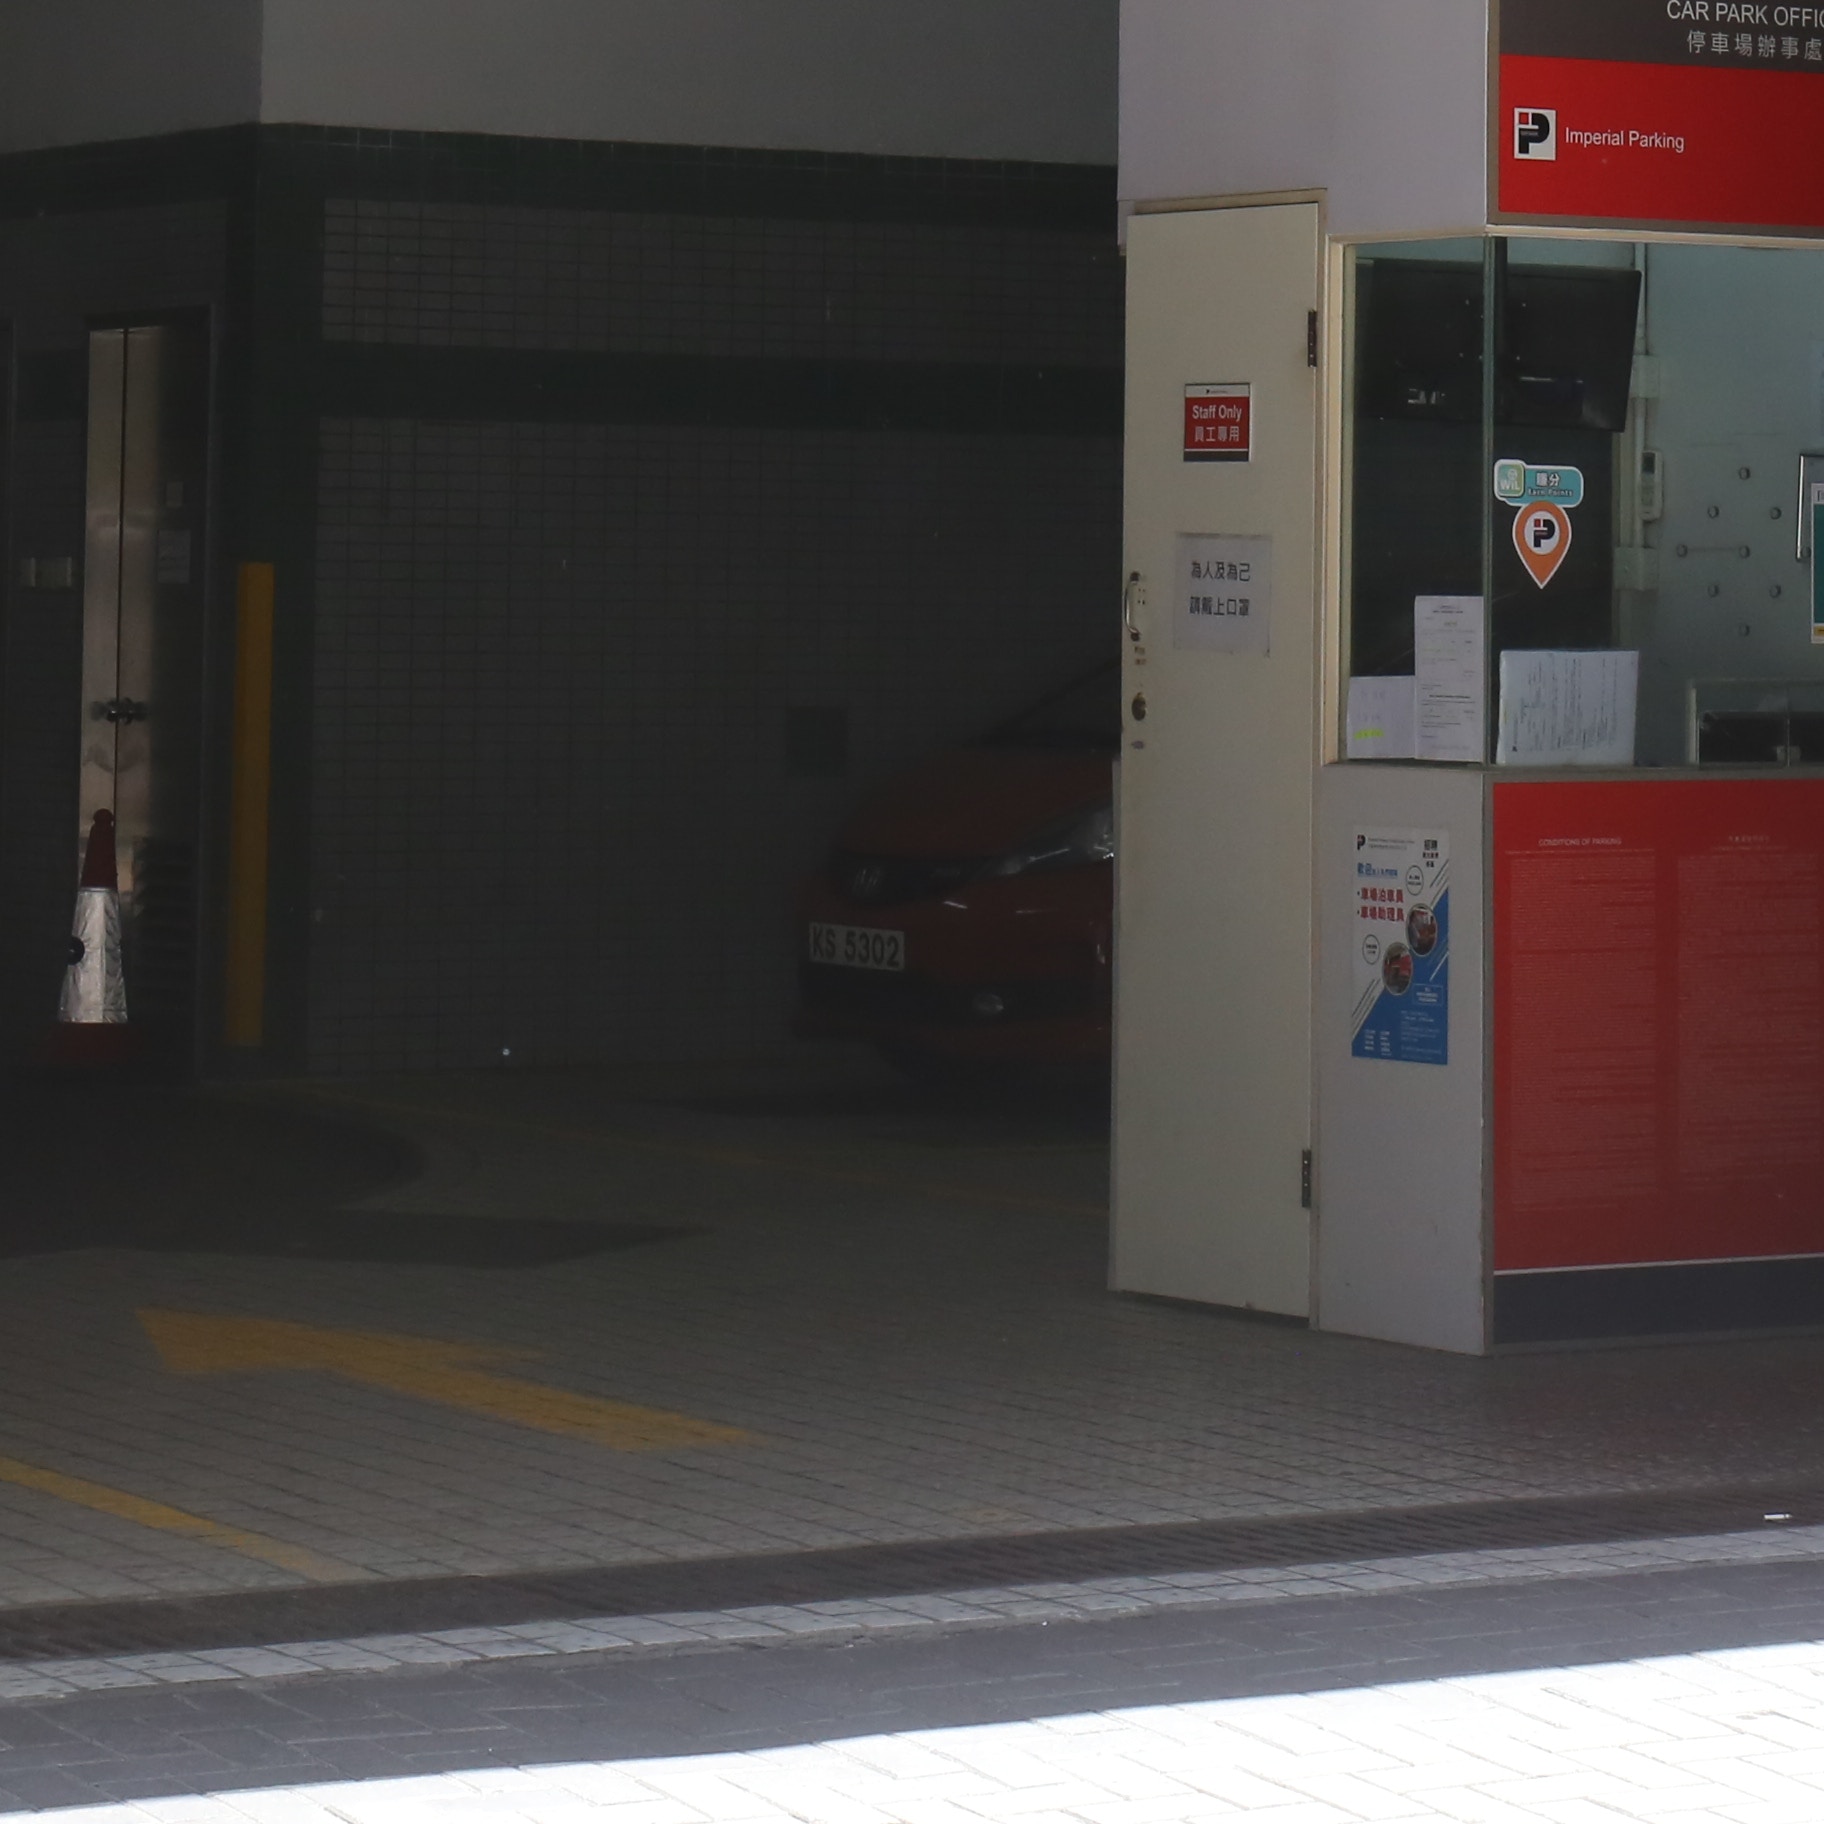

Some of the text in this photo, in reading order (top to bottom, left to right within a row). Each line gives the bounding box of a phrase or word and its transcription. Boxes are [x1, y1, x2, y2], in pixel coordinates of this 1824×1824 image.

[1714, 2, 1769, 26] PARK
[1564, 126, 1685, 154] Imperial Parking
[1192, 404, 1243, 423] Staff Only
[813, 926, 899, 967] KS 5302
